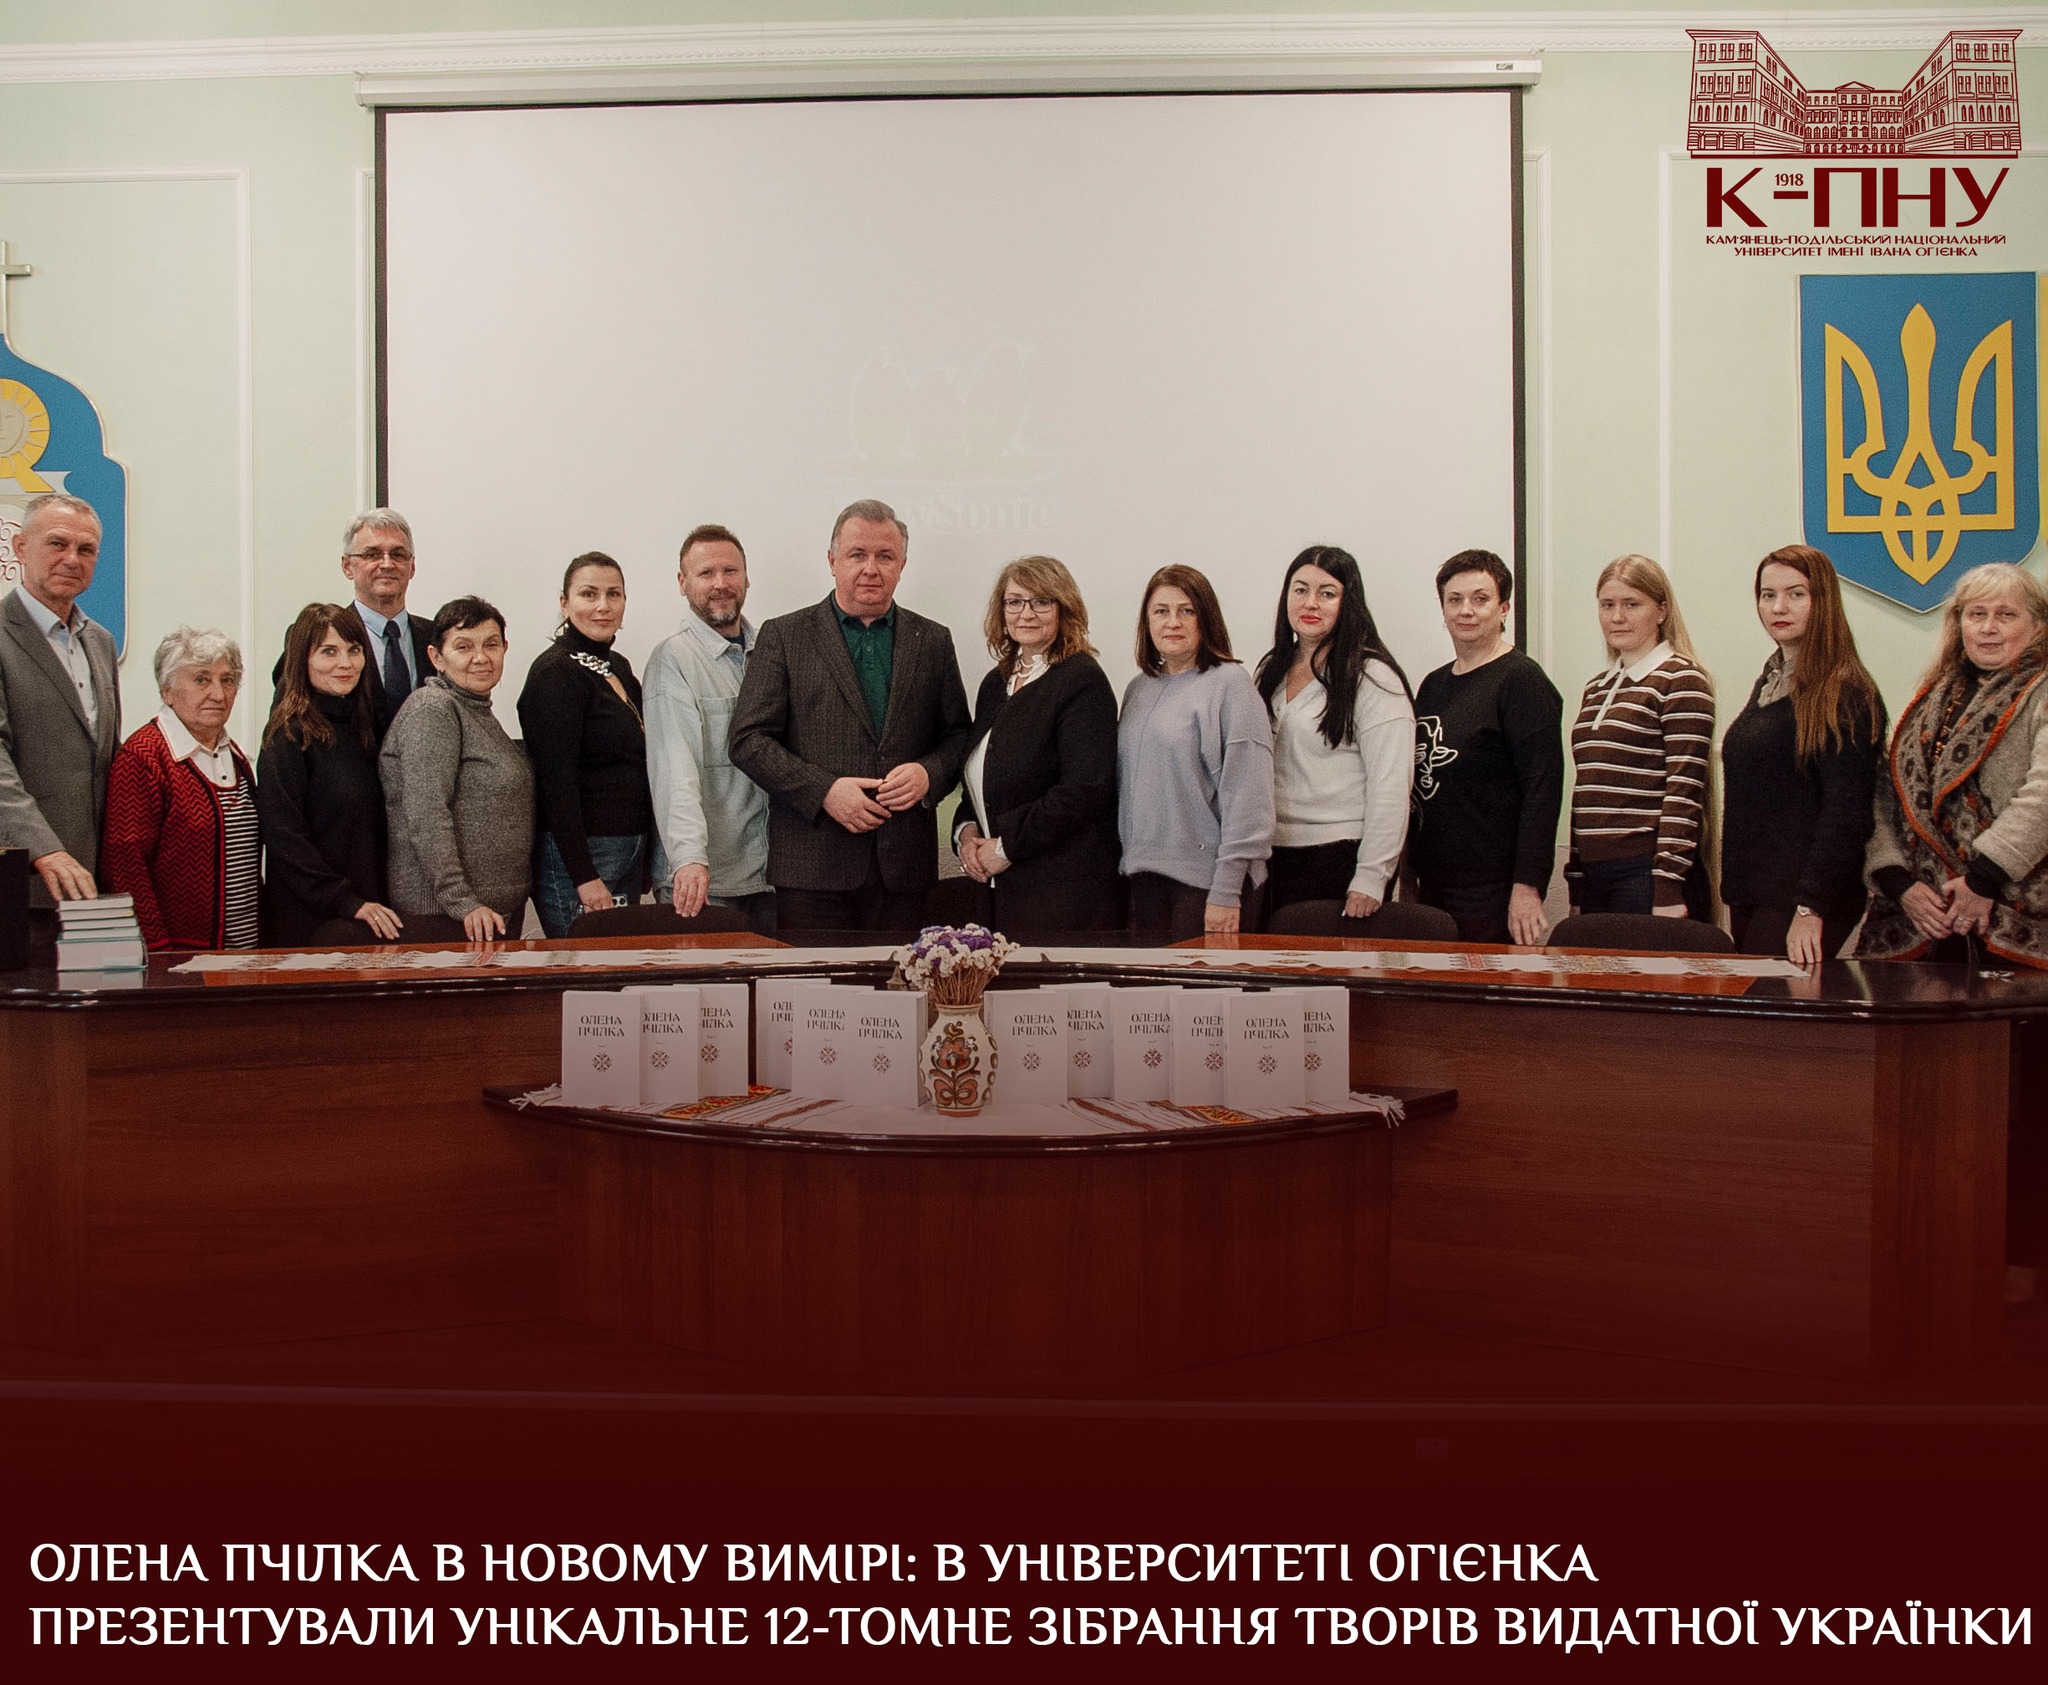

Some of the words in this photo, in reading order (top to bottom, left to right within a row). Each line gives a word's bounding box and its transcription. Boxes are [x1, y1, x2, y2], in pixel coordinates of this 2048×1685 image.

[898, 490, 1054, 532] wSonic
[700, 1007, 732, 1017] ЛЕНА
[1304, 1011, 1332, 1021] ЕНА
[580, 1014, 622, 1025] ОЛЕНА
[860, 1016, 900, 1028] ОЛЕНА
[1014, 1014, 1055, 1024] ОЛЕНА
[1131, 1013, 1171, 1023] ОЛЕНА
[1193, 1015, 1223, 1026] ОЛЕН
[1245, 1018, 1287, 1028] ОЛЕНА
[807, 1020, 845, 1031] ПЧІЛК
[1068, 1021, 1105, 1031] ЧІЛКА
[1303, 1023, 1335, 1033] ІЛКА
[578, 1026, 625, 1037] ПЧІЛКА
[858, 1028, 903, 1040] ПЧІЛКА
[1012, 1026, 1058, 1036] ПЧІЛКА
[1244, 1030, 1290, 1040] ПЧІЛКА
